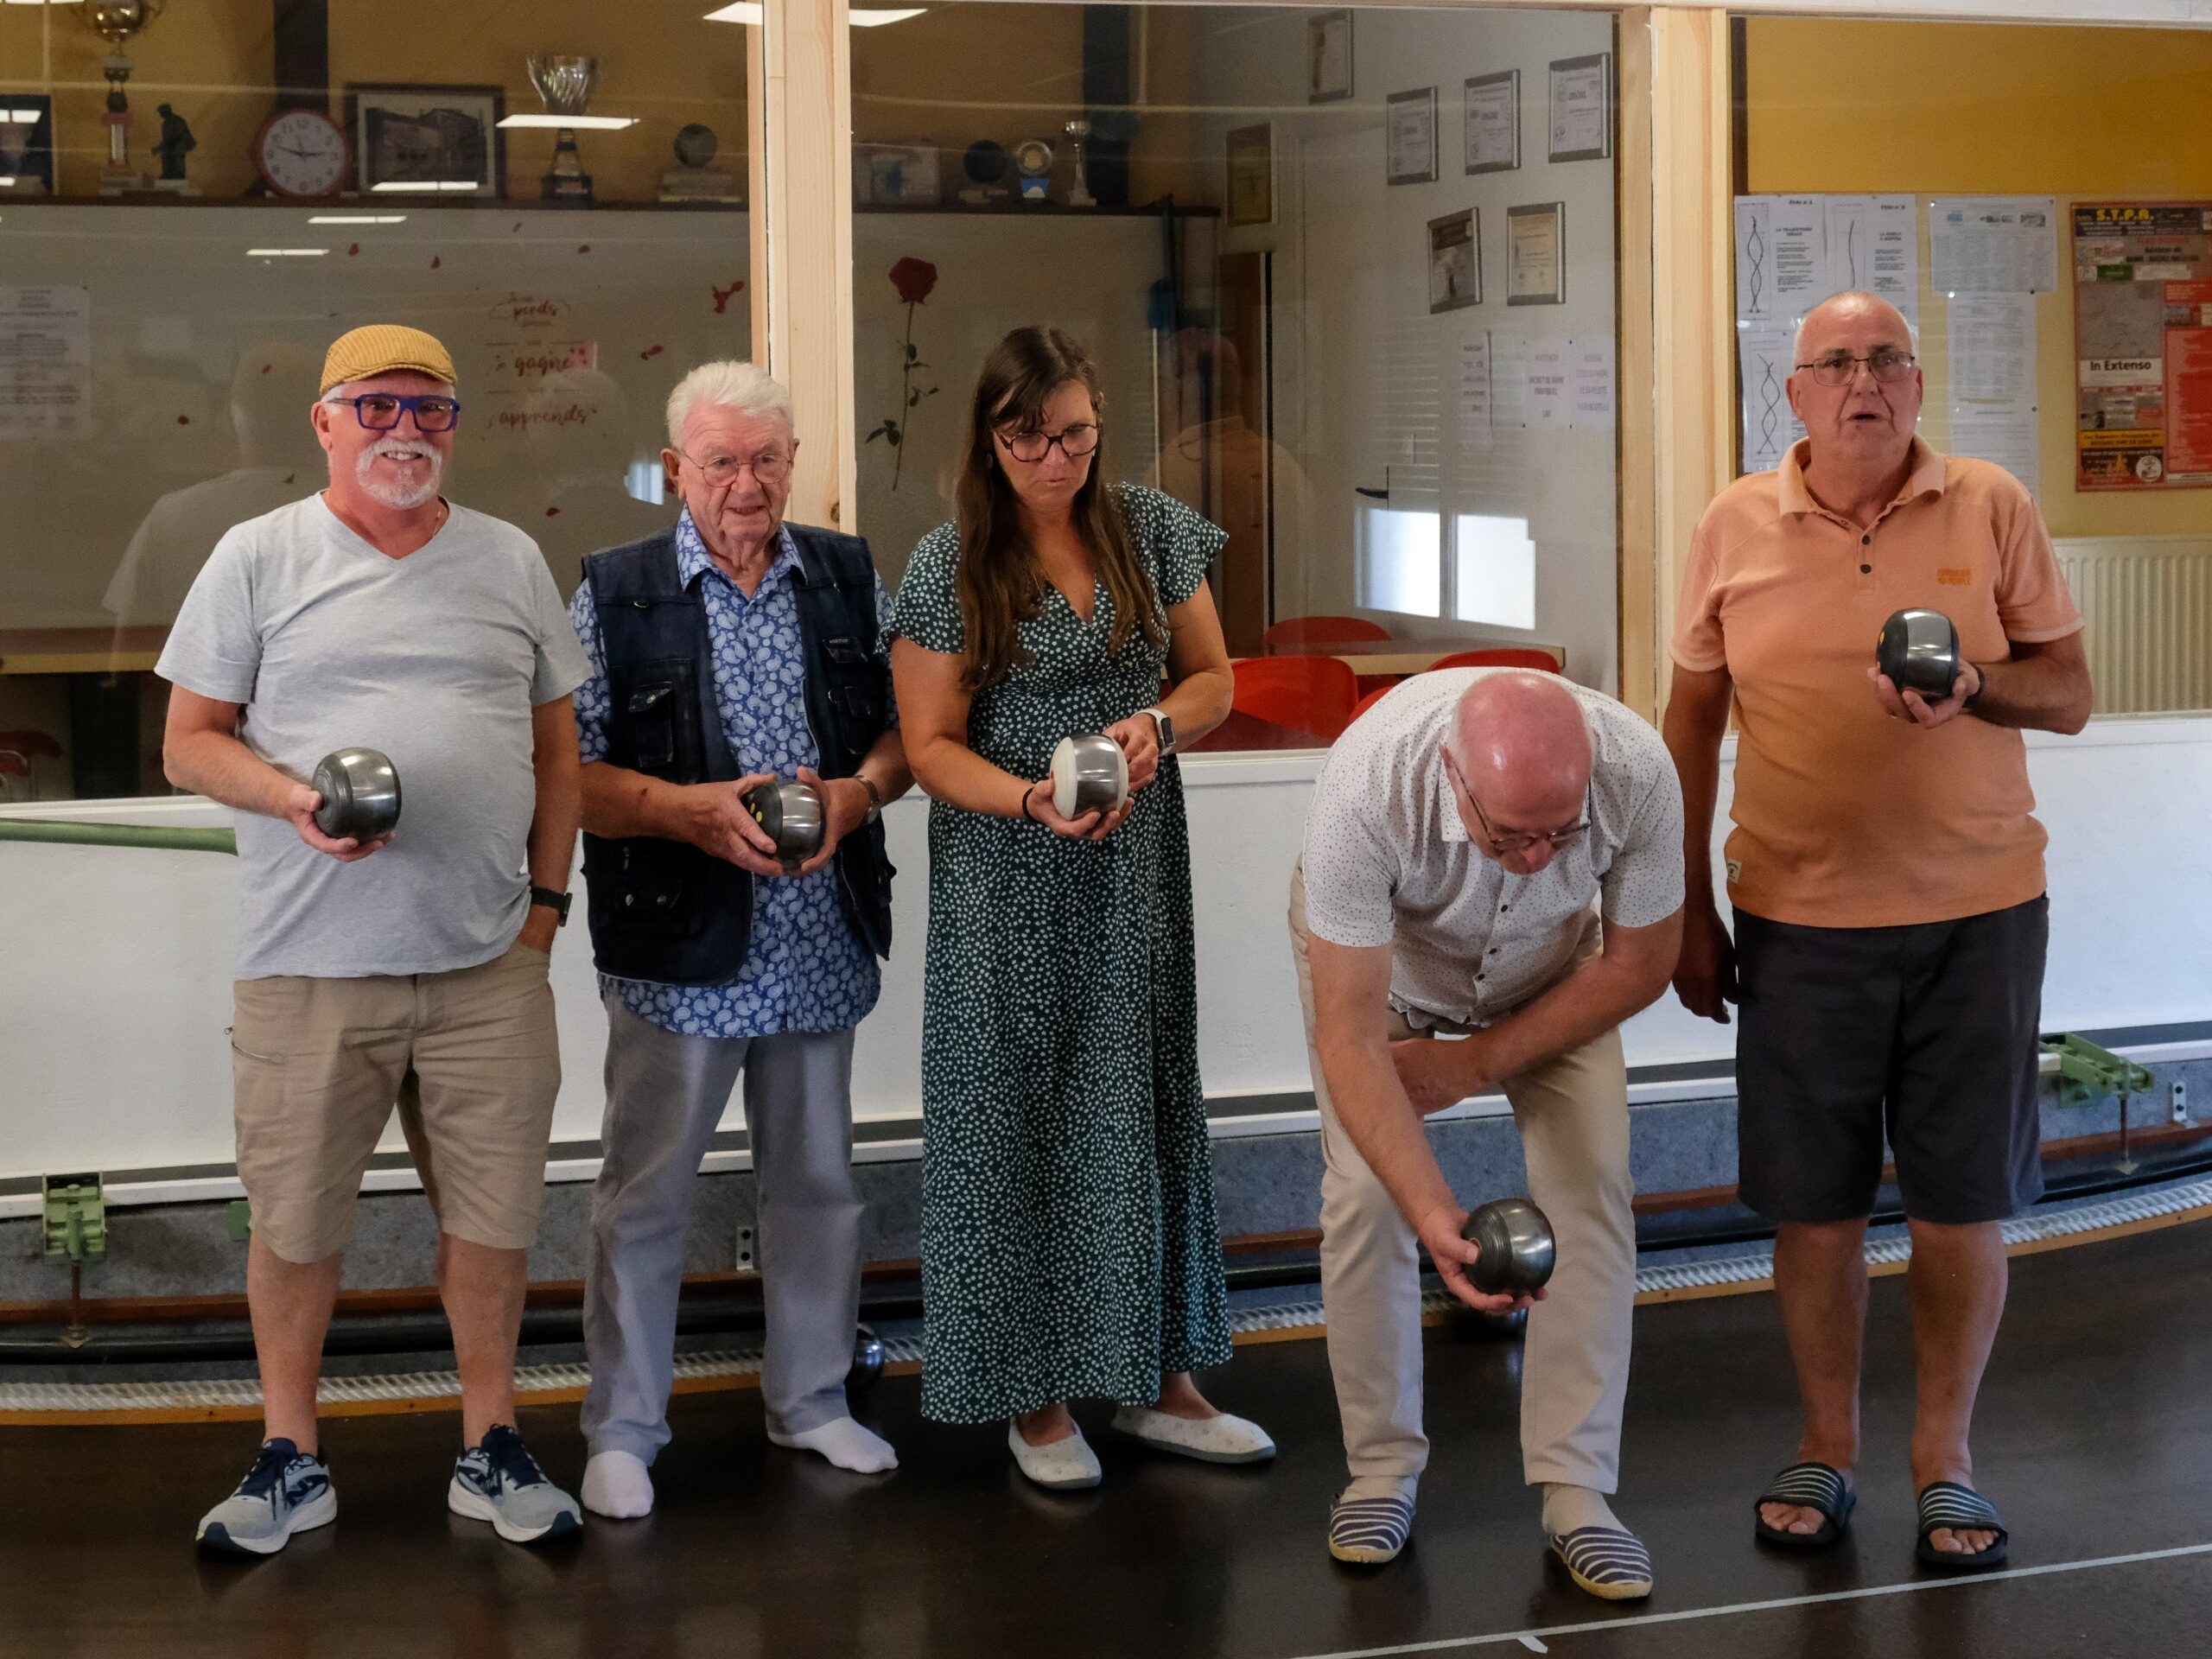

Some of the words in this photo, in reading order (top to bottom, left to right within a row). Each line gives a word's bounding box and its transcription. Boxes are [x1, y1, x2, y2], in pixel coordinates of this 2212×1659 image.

[515, 356, 573, 377] gagne
[2090, 361, 2101, 372] In
[2104, 359, 2152, 372] Extenso
